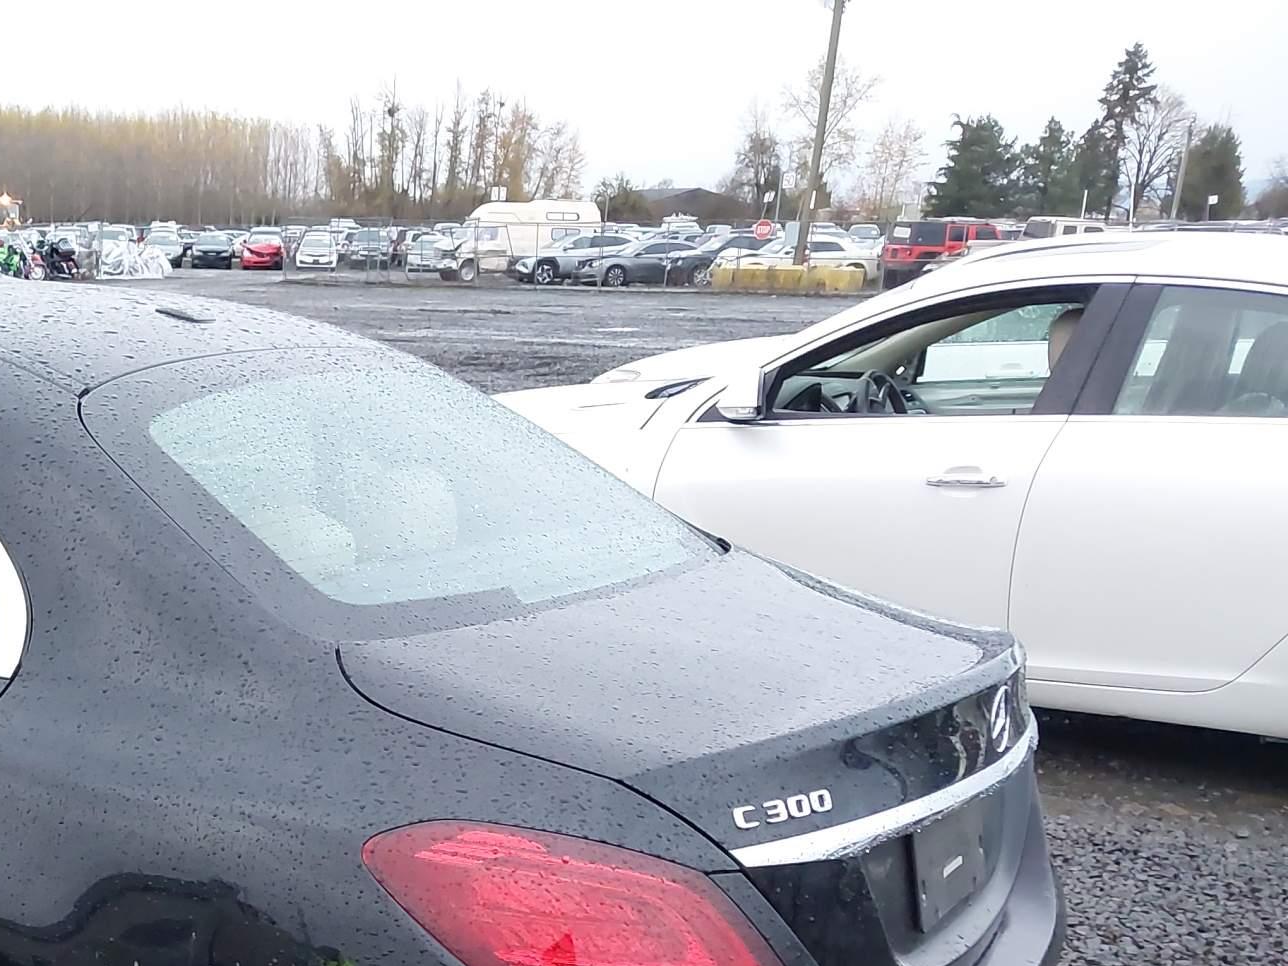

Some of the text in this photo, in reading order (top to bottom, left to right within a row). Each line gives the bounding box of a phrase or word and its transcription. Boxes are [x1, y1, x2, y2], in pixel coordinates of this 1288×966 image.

[756, 225, 771, 235] STOP
[732, 788, 833, 829] C 300
